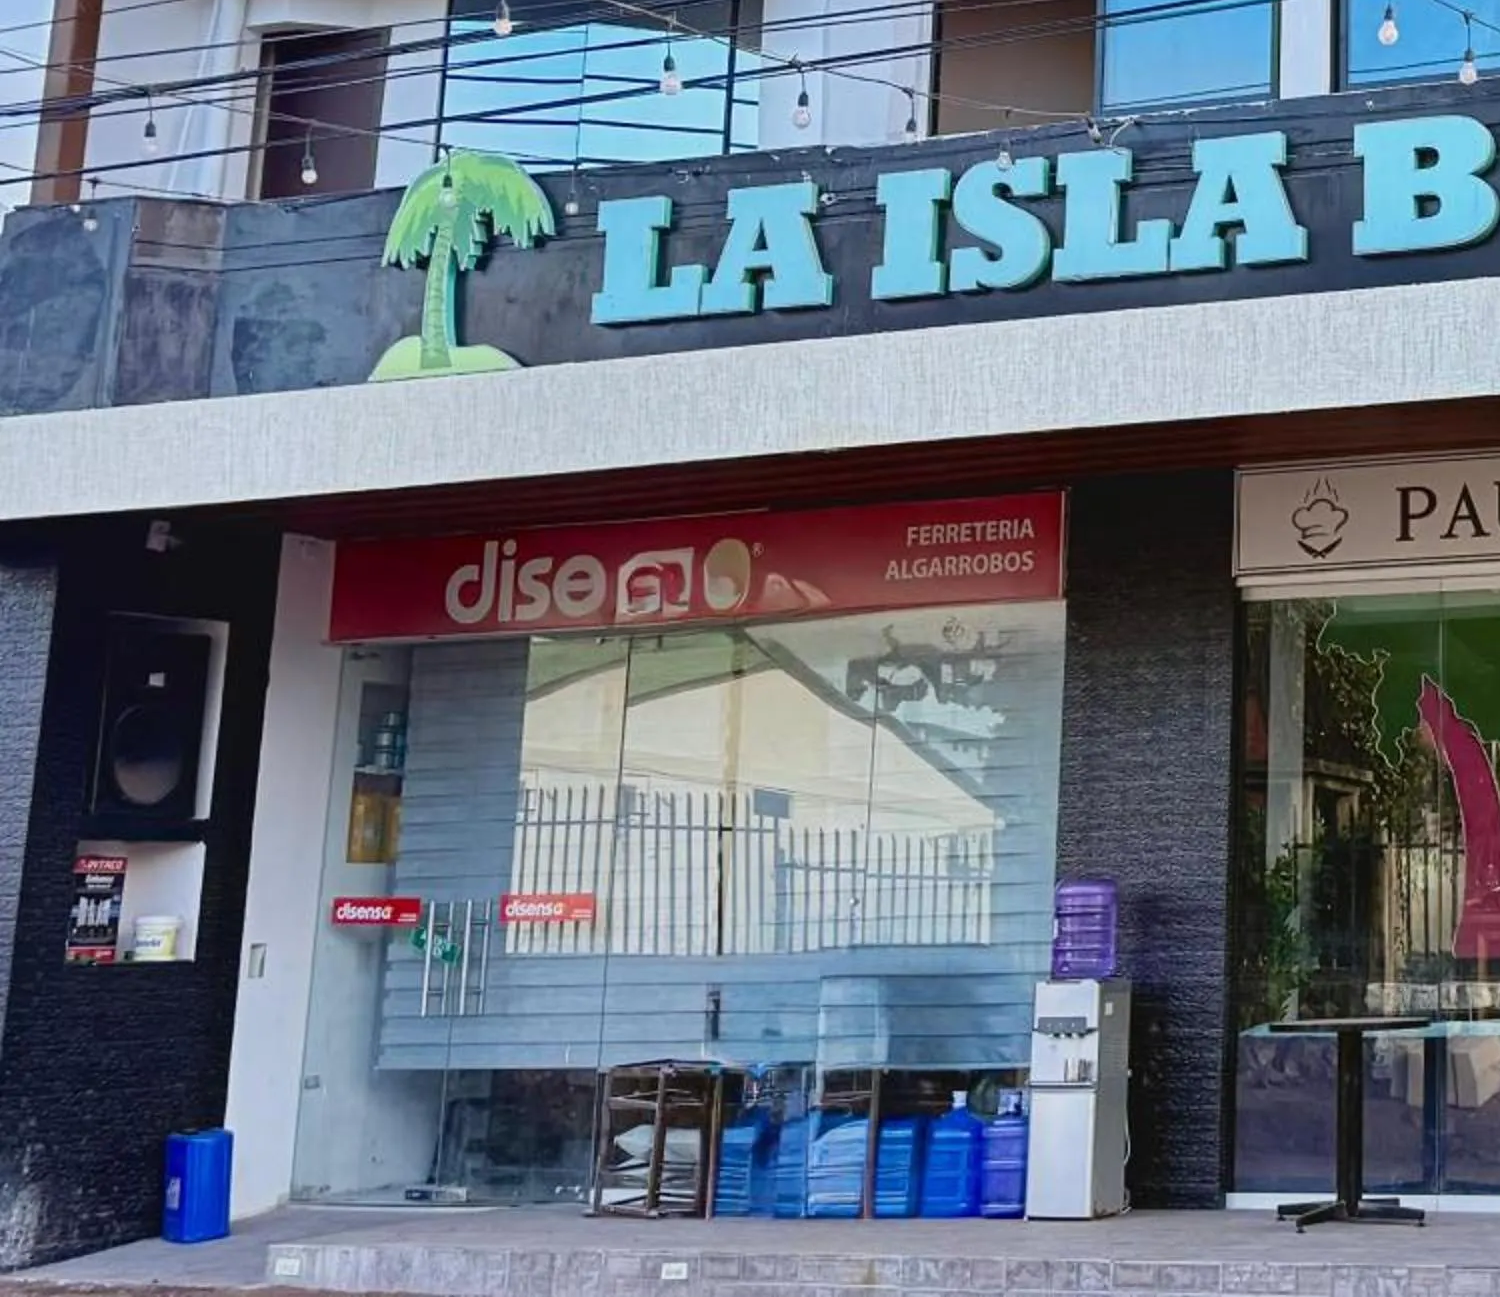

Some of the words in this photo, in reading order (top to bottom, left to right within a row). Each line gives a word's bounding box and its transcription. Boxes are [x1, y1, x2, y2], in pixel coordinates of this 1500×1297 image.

[591, 181, 833, 324] LA
[871, 130, 1309, 301] ISLA
[906, 518, 1035, 547] FERRETERIA
[885, 550, 1035, 581] ALGARROBOS
[335, 900, 394, 920] disensa
[504, 899, 564, 917] disensa
